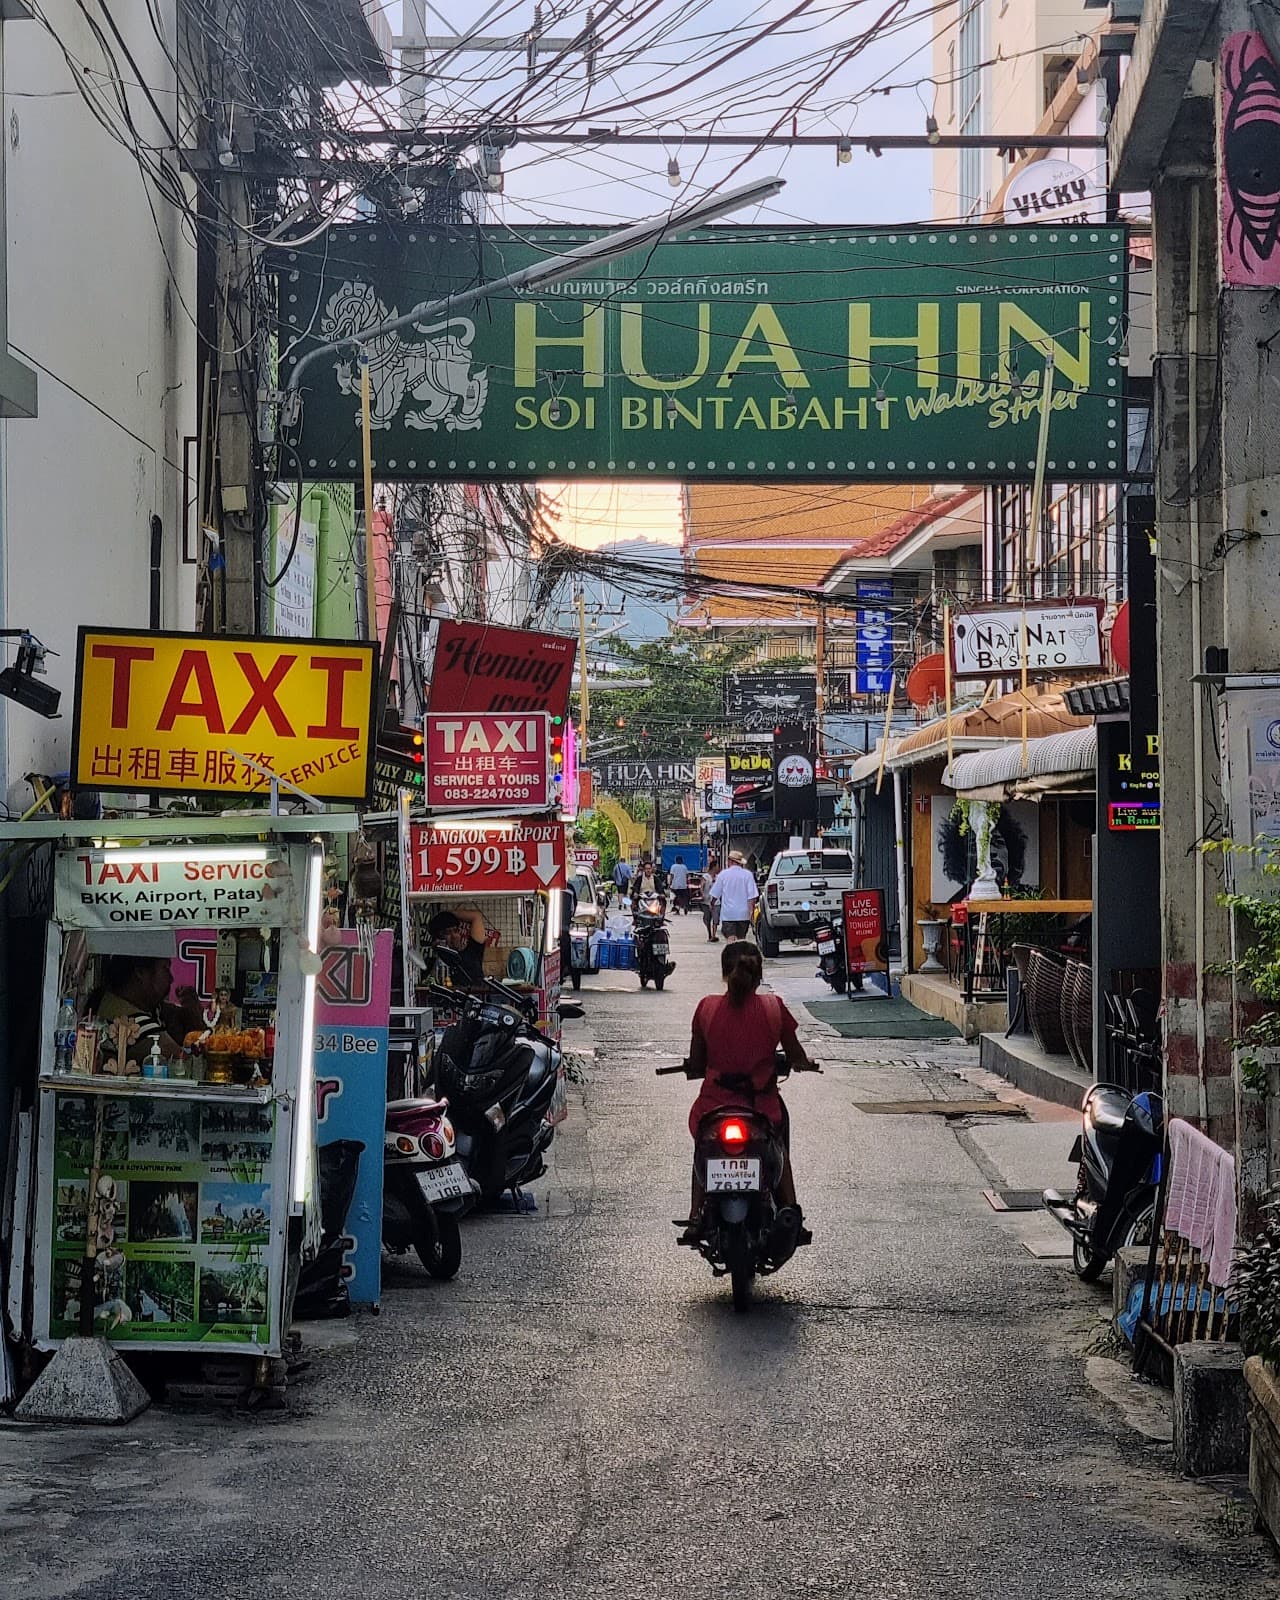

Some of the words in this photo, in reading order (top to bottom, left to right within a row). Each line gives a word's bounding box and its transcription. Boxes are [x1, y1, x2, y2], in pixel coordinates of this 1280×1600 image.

[1012, 179, 1086, 217] VICKY
[956, 285, 1000, 295] SINGHA
[1004, 284, 1089, 295] CORPORATION
[514, 303, 811, 391] HUA
[848, 301, 1091, 388] HIN
[905, 368, 1041, 421] Walking
[514, 396, 596, 431] SOI
[621, 396, 898, 431] BINTABAHT
[976, 626, 1016, 650] NAT
[1026, 623, 1066, 647] NAT
[445, 637, 565, 693] Heming
[976, 651, 1067, 669] BISTRO
[92, 644, 363, 741] TAXI
[436, 720, 537, 753] TAXI
[91, 744, 275, 793] 出租車服務
[281, 743, 361, 790] SERVICE
[455, 756, 518, 771] 出租车
[729, 755, 771, 770] DaDa
[434, 774, 487, 786] SERVICE
[487, 775, 496, 785] &
[500, 774, 540, 785] TOURS
[607, 763, 654, 781] HUA
[658, 763, 695, 781] HIN
[444, 788, 530, 799] 083-2247039
[77, 856, 159, 886] TAXI
[431, 883, 464, 891] Inclusive
[81, 891, 129, 906] BKK,
[134, 889, 207, 905] Airport,
[852, 899, 871, 909] LIVE
[109, 909, 152, 922] ONE
[159, 907, 199, 921] DAY
[205, 906, 250, 920] TRIP
[848, 907, 878, 917] MUSIC
[849, 921, 877, 929] TONIGHT
[342, 1034, 378, 1052] Bee
[438, 1185, 461, 1199] 109
[714, 1181, 752, 1190] 7617
